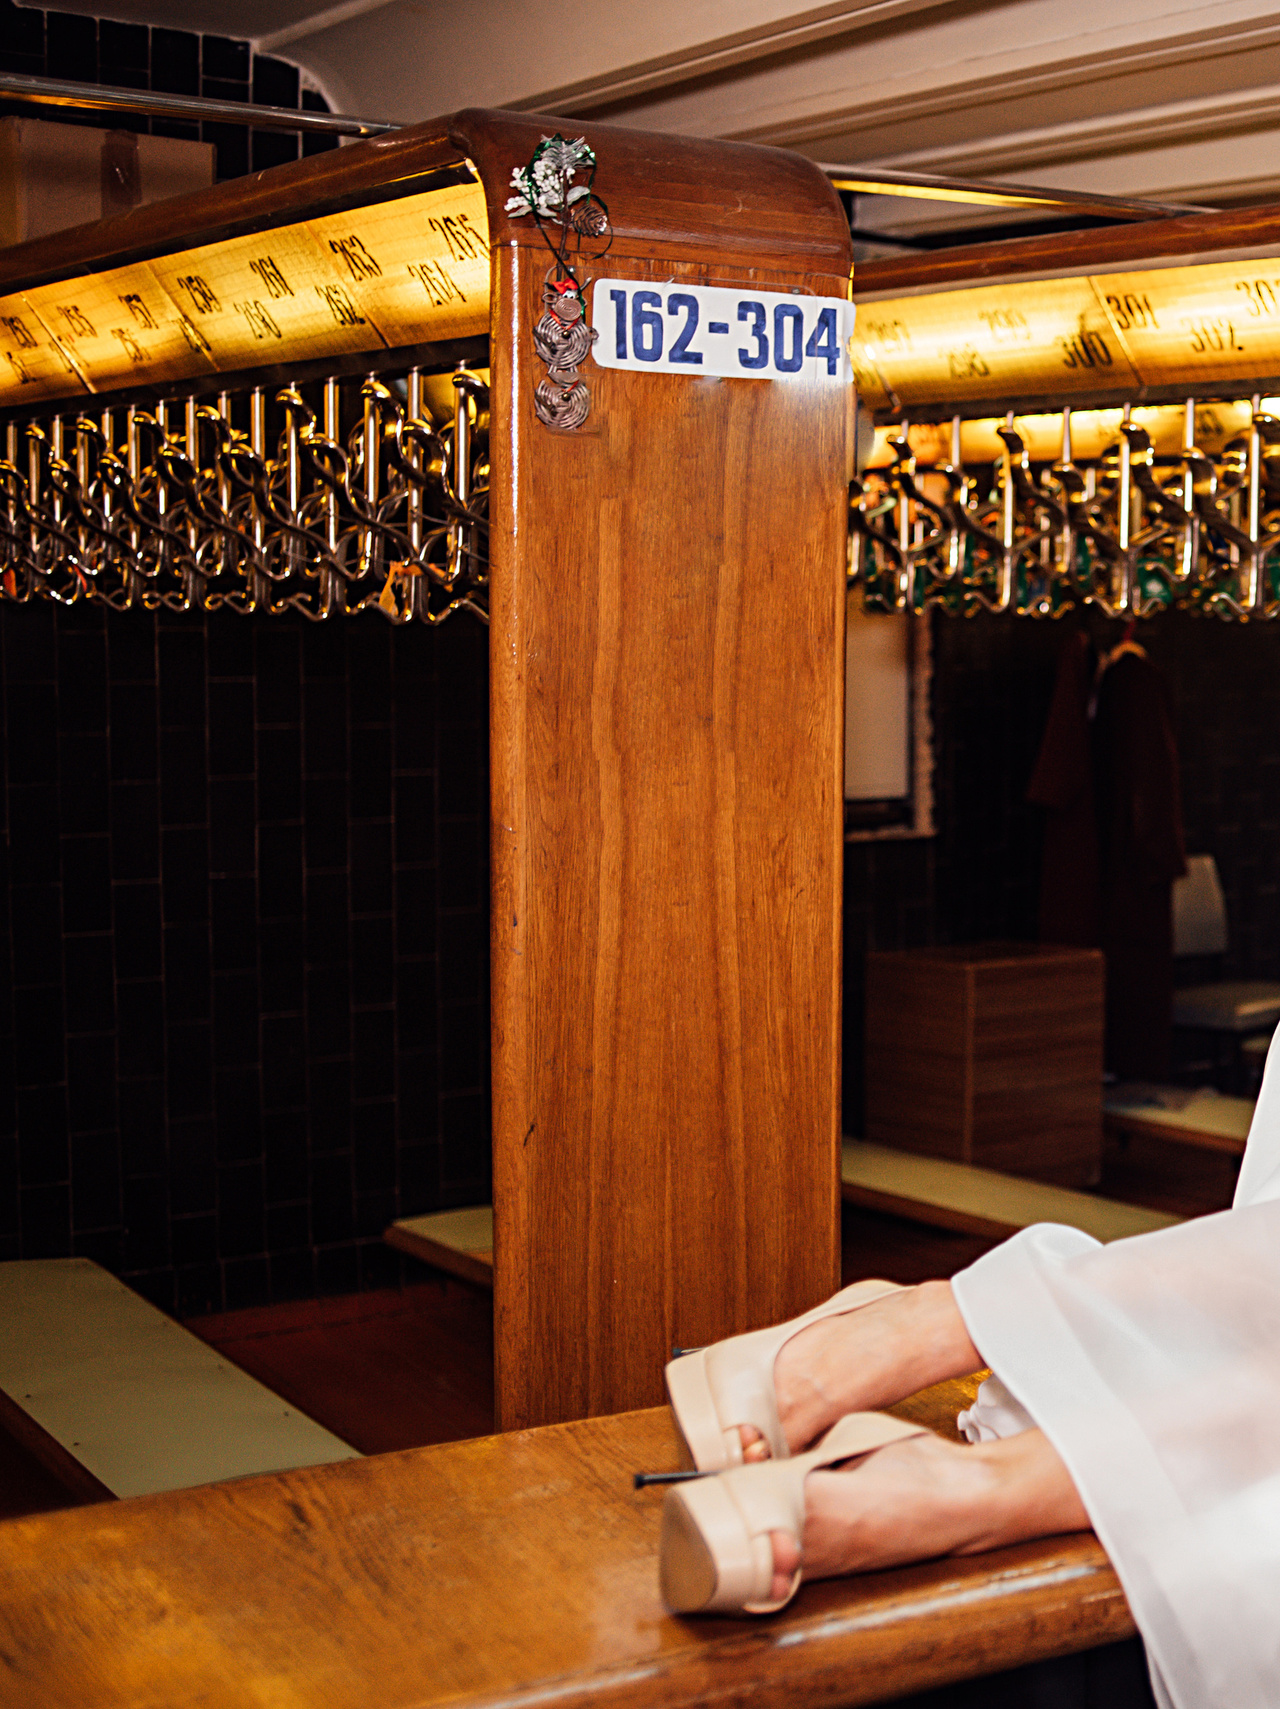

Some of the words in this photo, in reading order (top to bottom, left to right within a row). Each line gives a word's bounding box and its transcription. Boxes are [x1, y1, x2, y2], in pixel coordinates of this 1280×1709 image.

[329, 235, 382, 281] 263
[428, 214, 490, 262] 265
[249, 255, 294, 298] 261
[407, 260, 468, 307] 264
[314, 284, 366, 325] 262
[1106, 294, 1159, 329] 301
[610, 289, 840, 375] 162-304
[1182, 316, 1244, 352] 302
